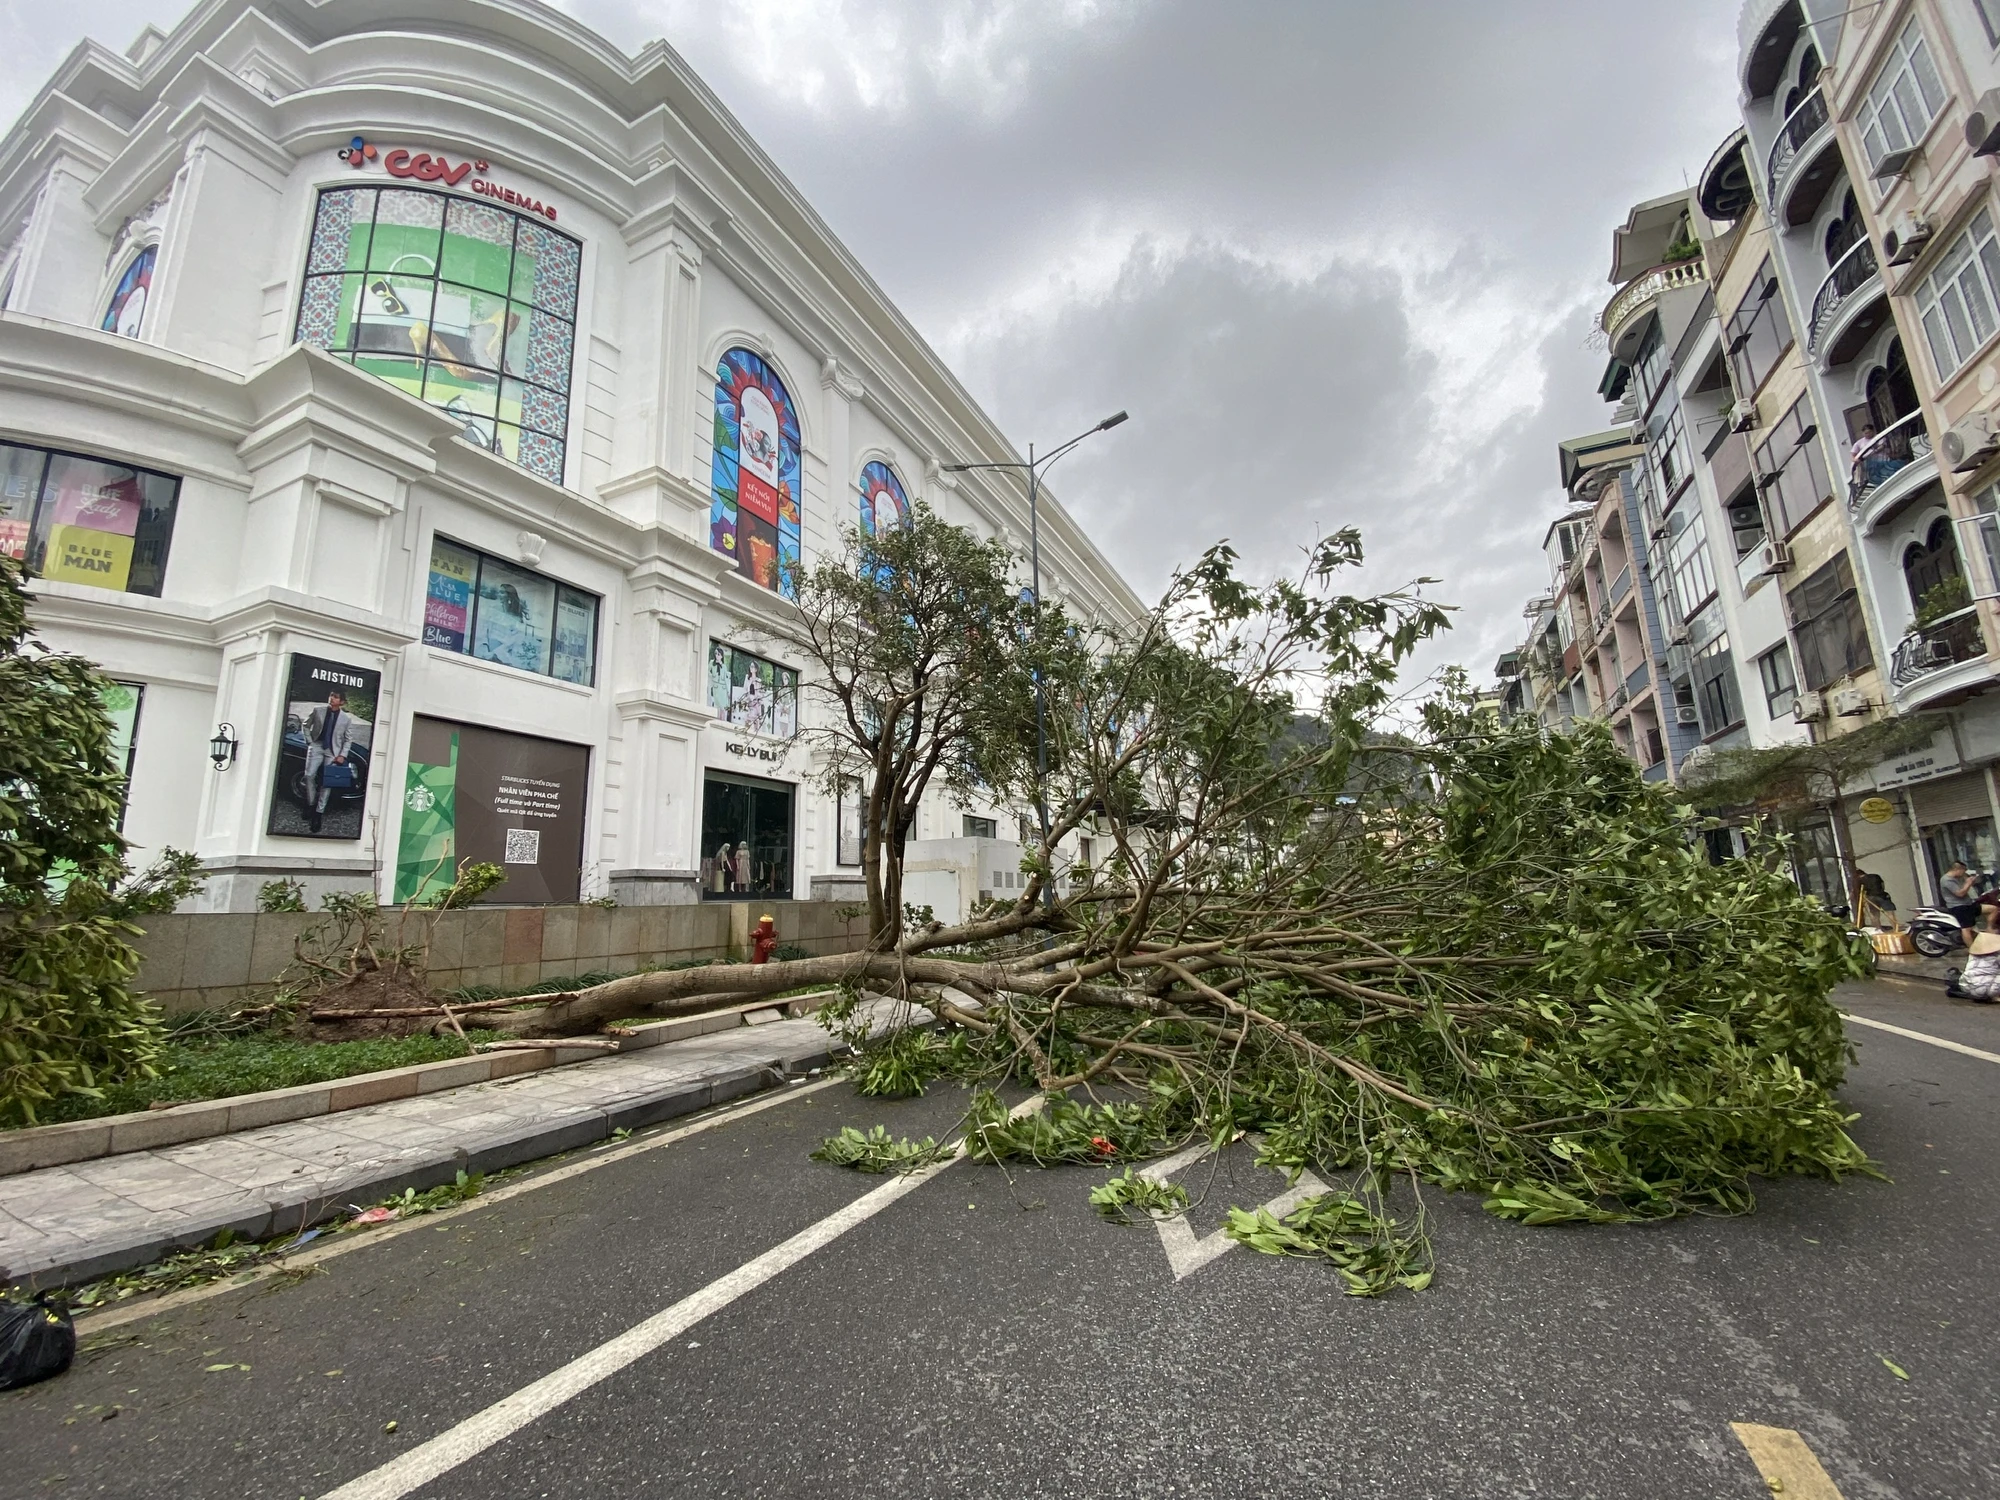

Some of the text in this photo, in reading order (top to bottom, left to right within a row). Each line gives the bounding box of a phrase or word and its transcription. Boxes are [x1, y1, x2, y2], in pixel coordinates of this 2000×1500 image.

[385, 149, 472, 186] CGV
[471, 178, 557, 220] CINEMAS
[81, 484, 123, 501] BLUE
[76, 498, 122, 519] Lady
[68, 544, 112, 558] BLUE
[63, 554, 114, 573] MAN
[423, 626, 452, 645] Blue
[311, 668, 363, 688] ARISTINO
[501, 775, 530, 784] STARBUCKS
[499, 786, 559, 800] NHÂN VIÊN PHA CHẾ
[508, 798, 523, 806] time
[532, 801, 545, 809] Part
[545, 803, 561, 811] time)
